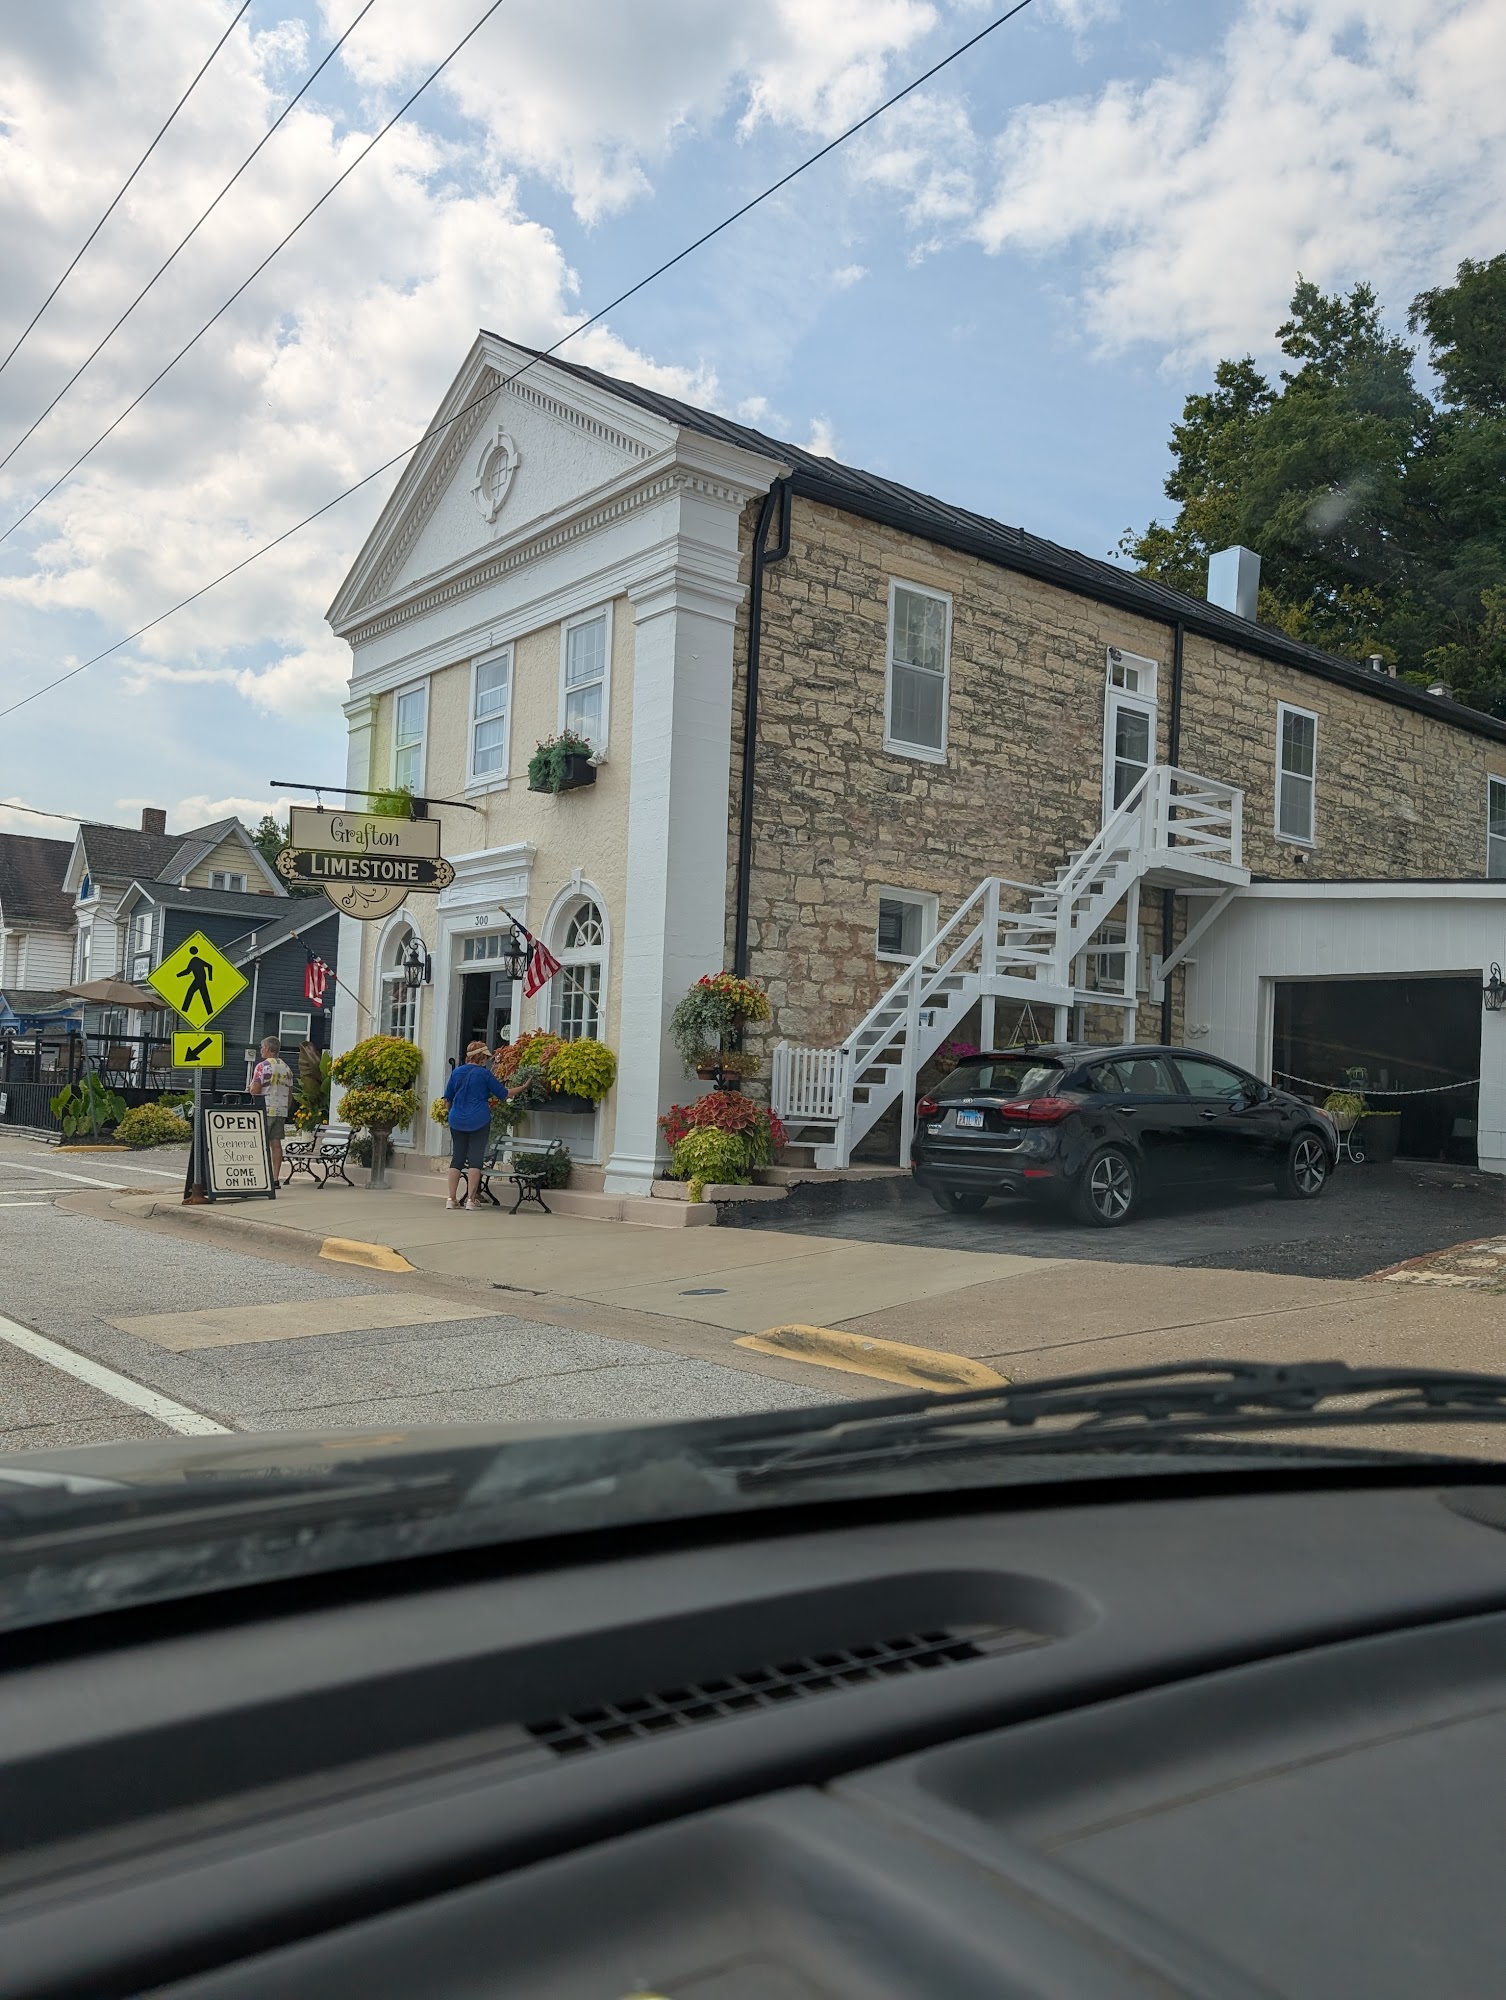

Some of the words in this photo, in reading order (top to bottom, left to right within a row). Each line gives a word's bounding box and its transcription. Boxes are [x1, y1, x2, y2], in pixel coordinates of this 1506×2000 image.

[331, 816, 400, 852] Grafton
[311, 853, 419, 880] LIMESTONE
[475, 915, 489, 926] 300
[213, 1114, 257, 1129] OPEN
[216, 1135, 257, 1148] General
[223, 1149, 254, 1162] Store
[226, 1167, 255, 1177] COME
[225, 1178, 239, 1187] ON
[243, 1177, 257, 1187] IN!
